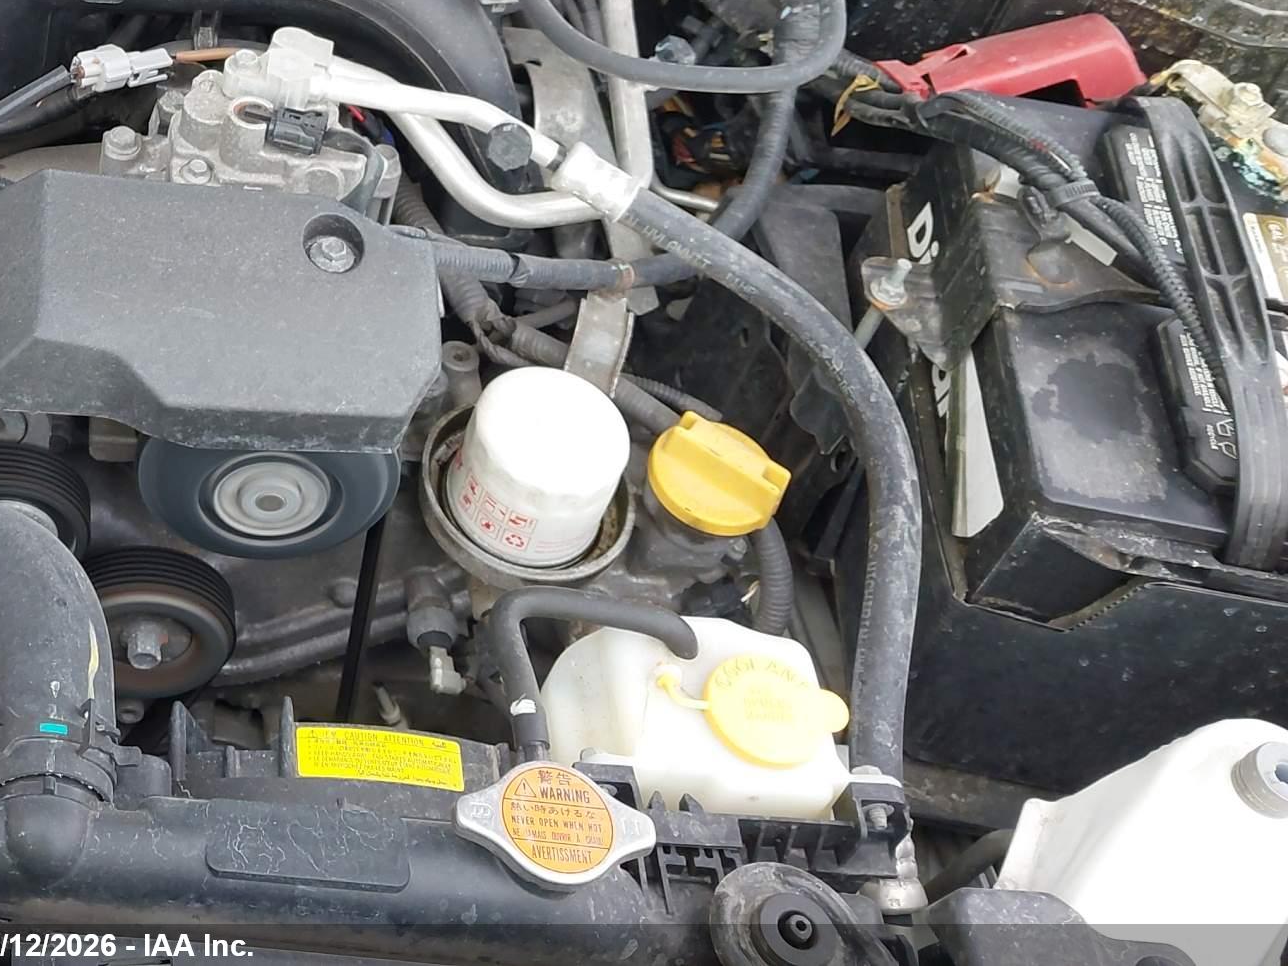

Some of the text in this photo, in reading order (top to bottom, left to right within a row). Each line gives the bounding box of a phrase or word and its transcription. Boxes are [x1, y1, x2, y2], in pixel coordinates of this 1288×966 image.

[539, 785, 591, 804] WARNING
[511, 815, 602, 834] NEVER OPEN WHEN HOT
[531, 844, 592, 864] AVERTISSMENT
